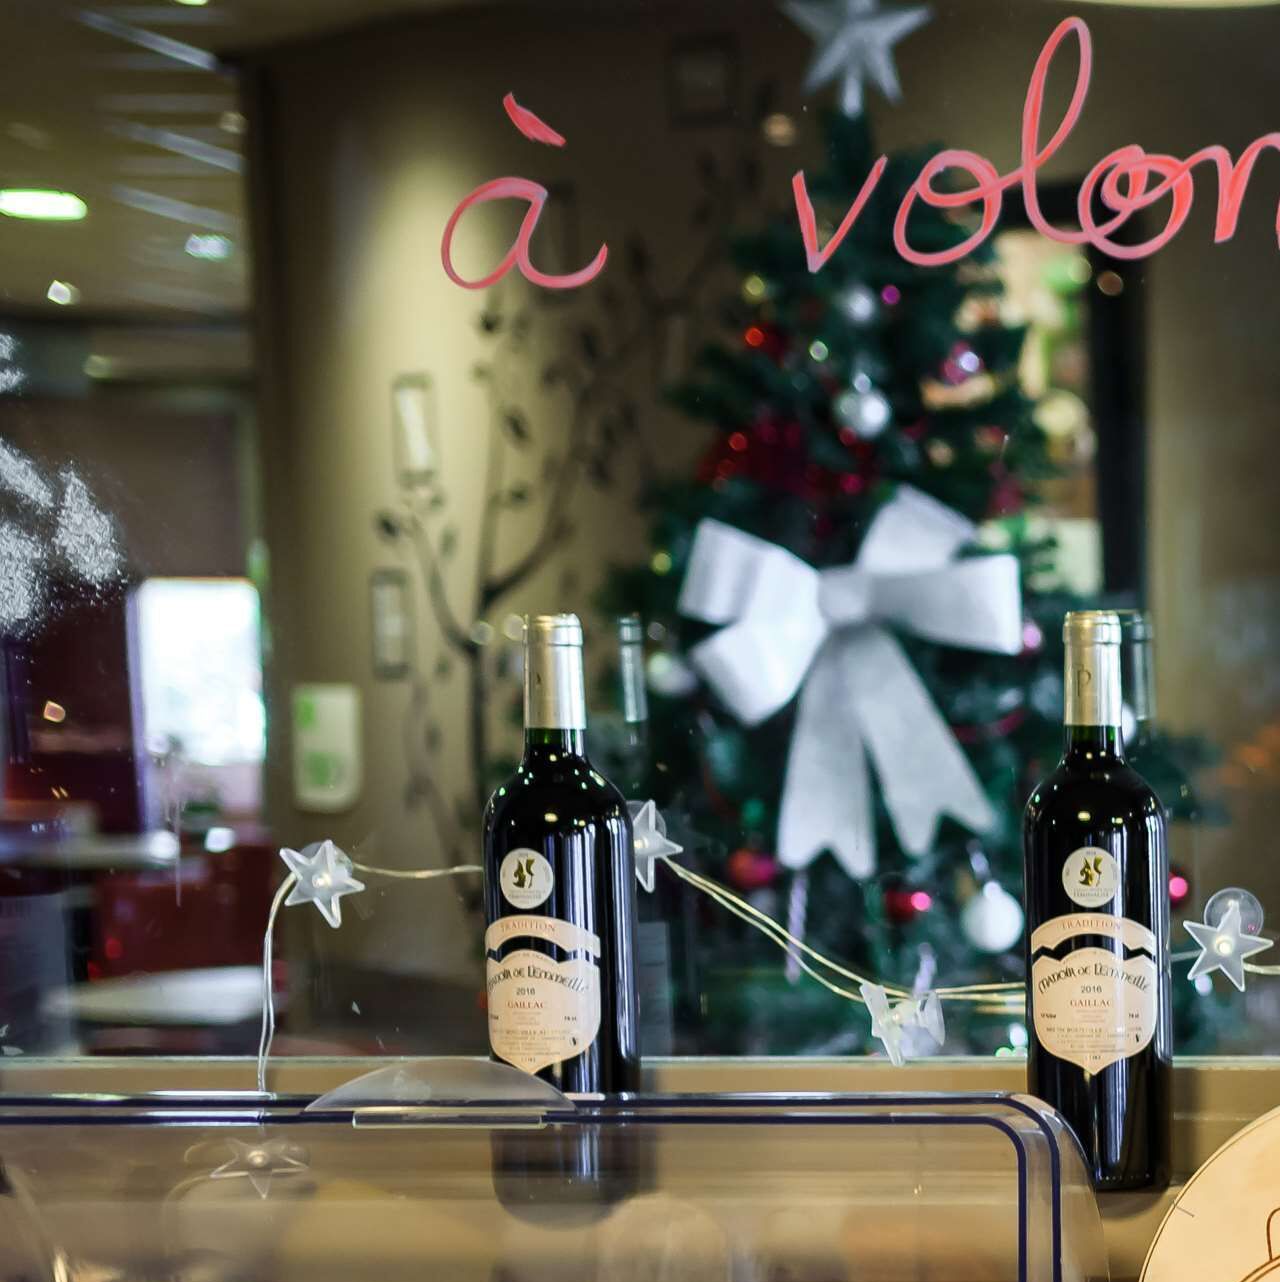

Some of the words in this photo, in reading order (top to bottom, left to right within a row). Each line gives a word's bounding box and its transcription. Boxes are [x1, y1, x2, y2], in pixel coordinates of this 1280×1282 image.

[440, 92, 609, 289] à
[501, 919, 556, 932] TRADITION
[1062, 919, 1121, 930] TRADITION
[1080, 985, 1103, 994] 2016
[1069, 999, 1112, 1007] GAILLAC
